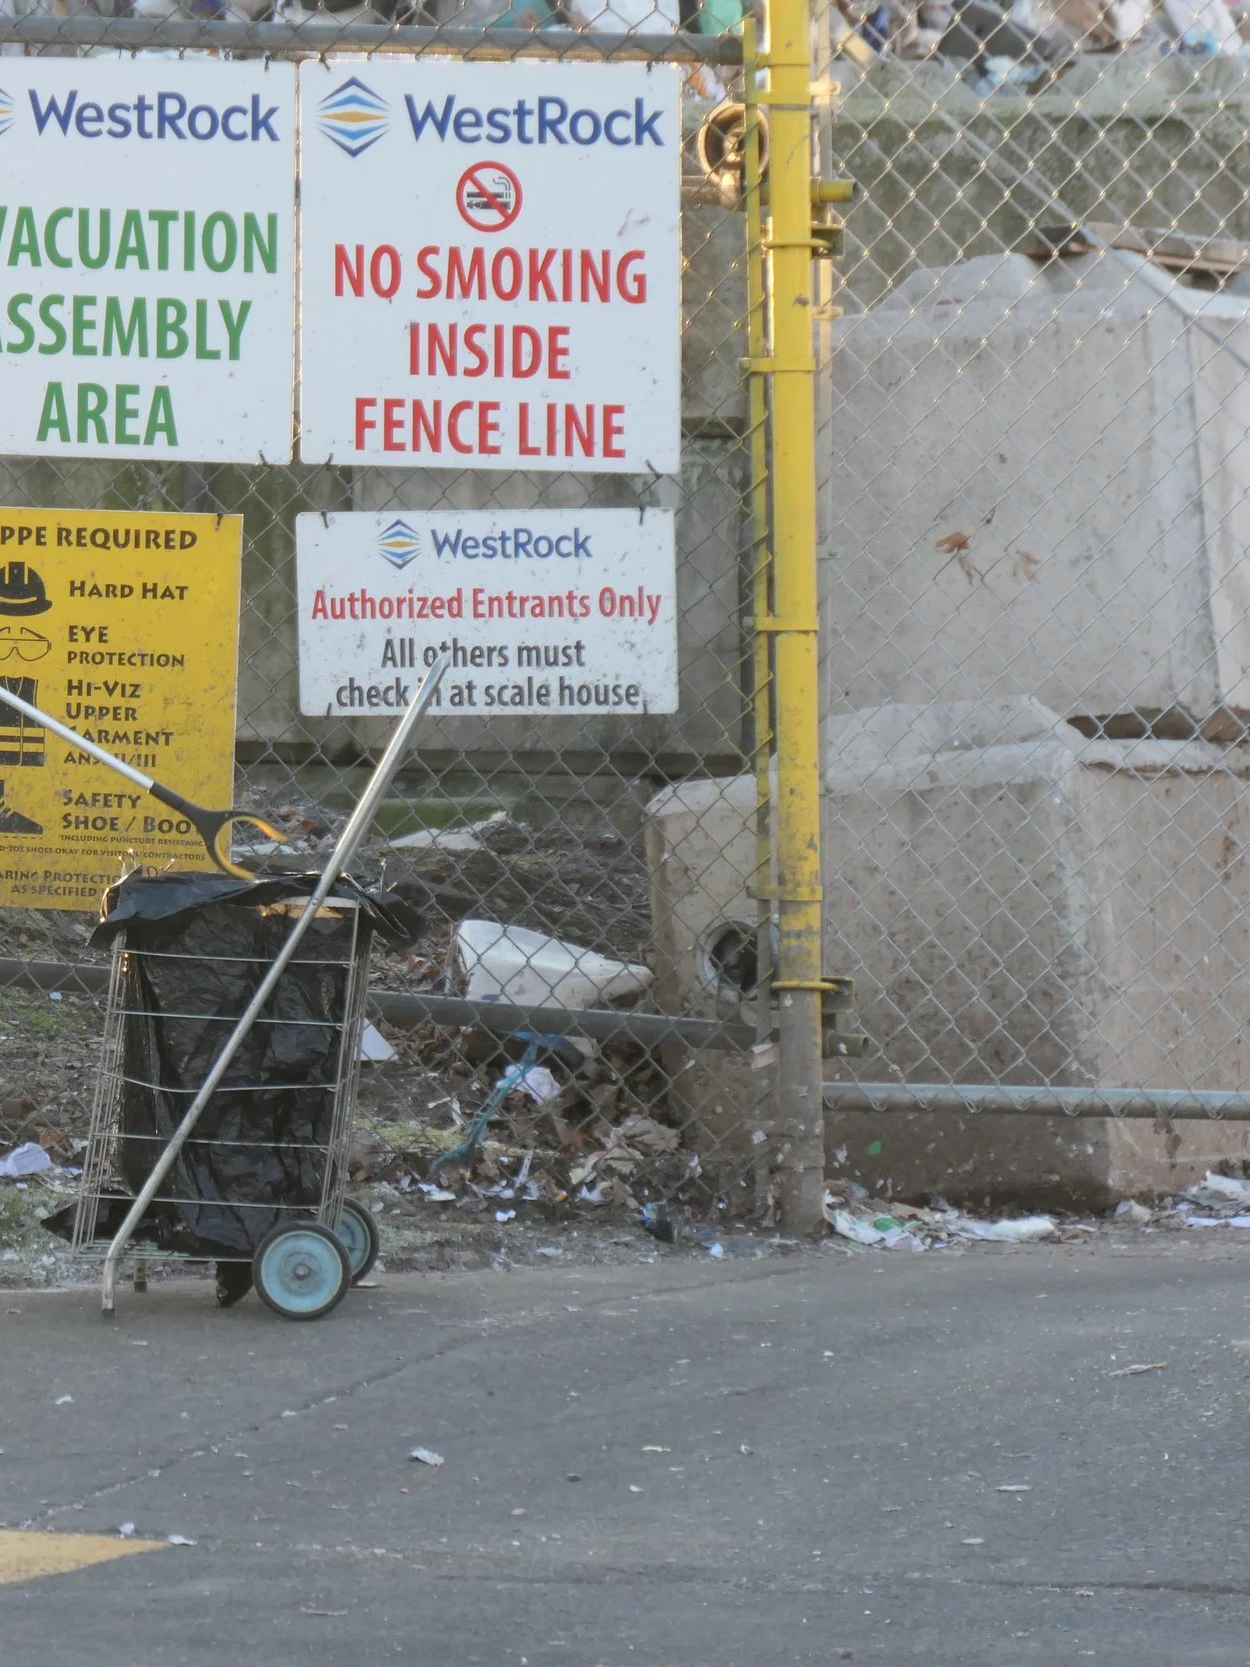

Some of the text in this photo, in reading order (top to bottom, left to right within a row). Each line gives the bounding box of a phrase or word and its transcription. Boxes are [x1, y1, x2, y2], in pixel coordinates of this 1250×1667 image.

[28, 88, 280, 142] WestRock
[405, 93, 665, 148] WestRock
[334, 244, 647, 303] NO SMOKING
[409, 322, 571, 379] INSIDE
[36, 381, 178, 446] AREA
[355, 397, 626, 458] FENCE LINE
[0, 526, 198, 550] PPE REQUIRED
[431, 527, 592, 560] WestRock
[69, 580, 189, 601] HARD HAT
[312, 586, 662, 625] Authorized Entrants Only
[68, 625, 109, 643] EYE
[67, 651, 185, 668] PROTECTION
[381, 638, 586, 668] All others must
[67, 679, 141, 699] HI-VIZ
[336, 677, 410, 707] check
[450, 681, 475, 707] at
[484, 677, 550, 707] scale
[559, 676, 640, 706] house
[66, 702, 138, 721] UPPER
[68, 725, 174, 746] ARMENT
[63, 789, 142, 808] SAFETY
[62, 813, 201, 835] SHOE / BOO
[55, 847, 79, 855] OKAY
[81, 848, 98, 856] FOR
[158, 838, 206, 847] RESISTANC
[44, 870, 121, 885] PROTECTIO
[31, 885, 97, 897] SPECIFIED
